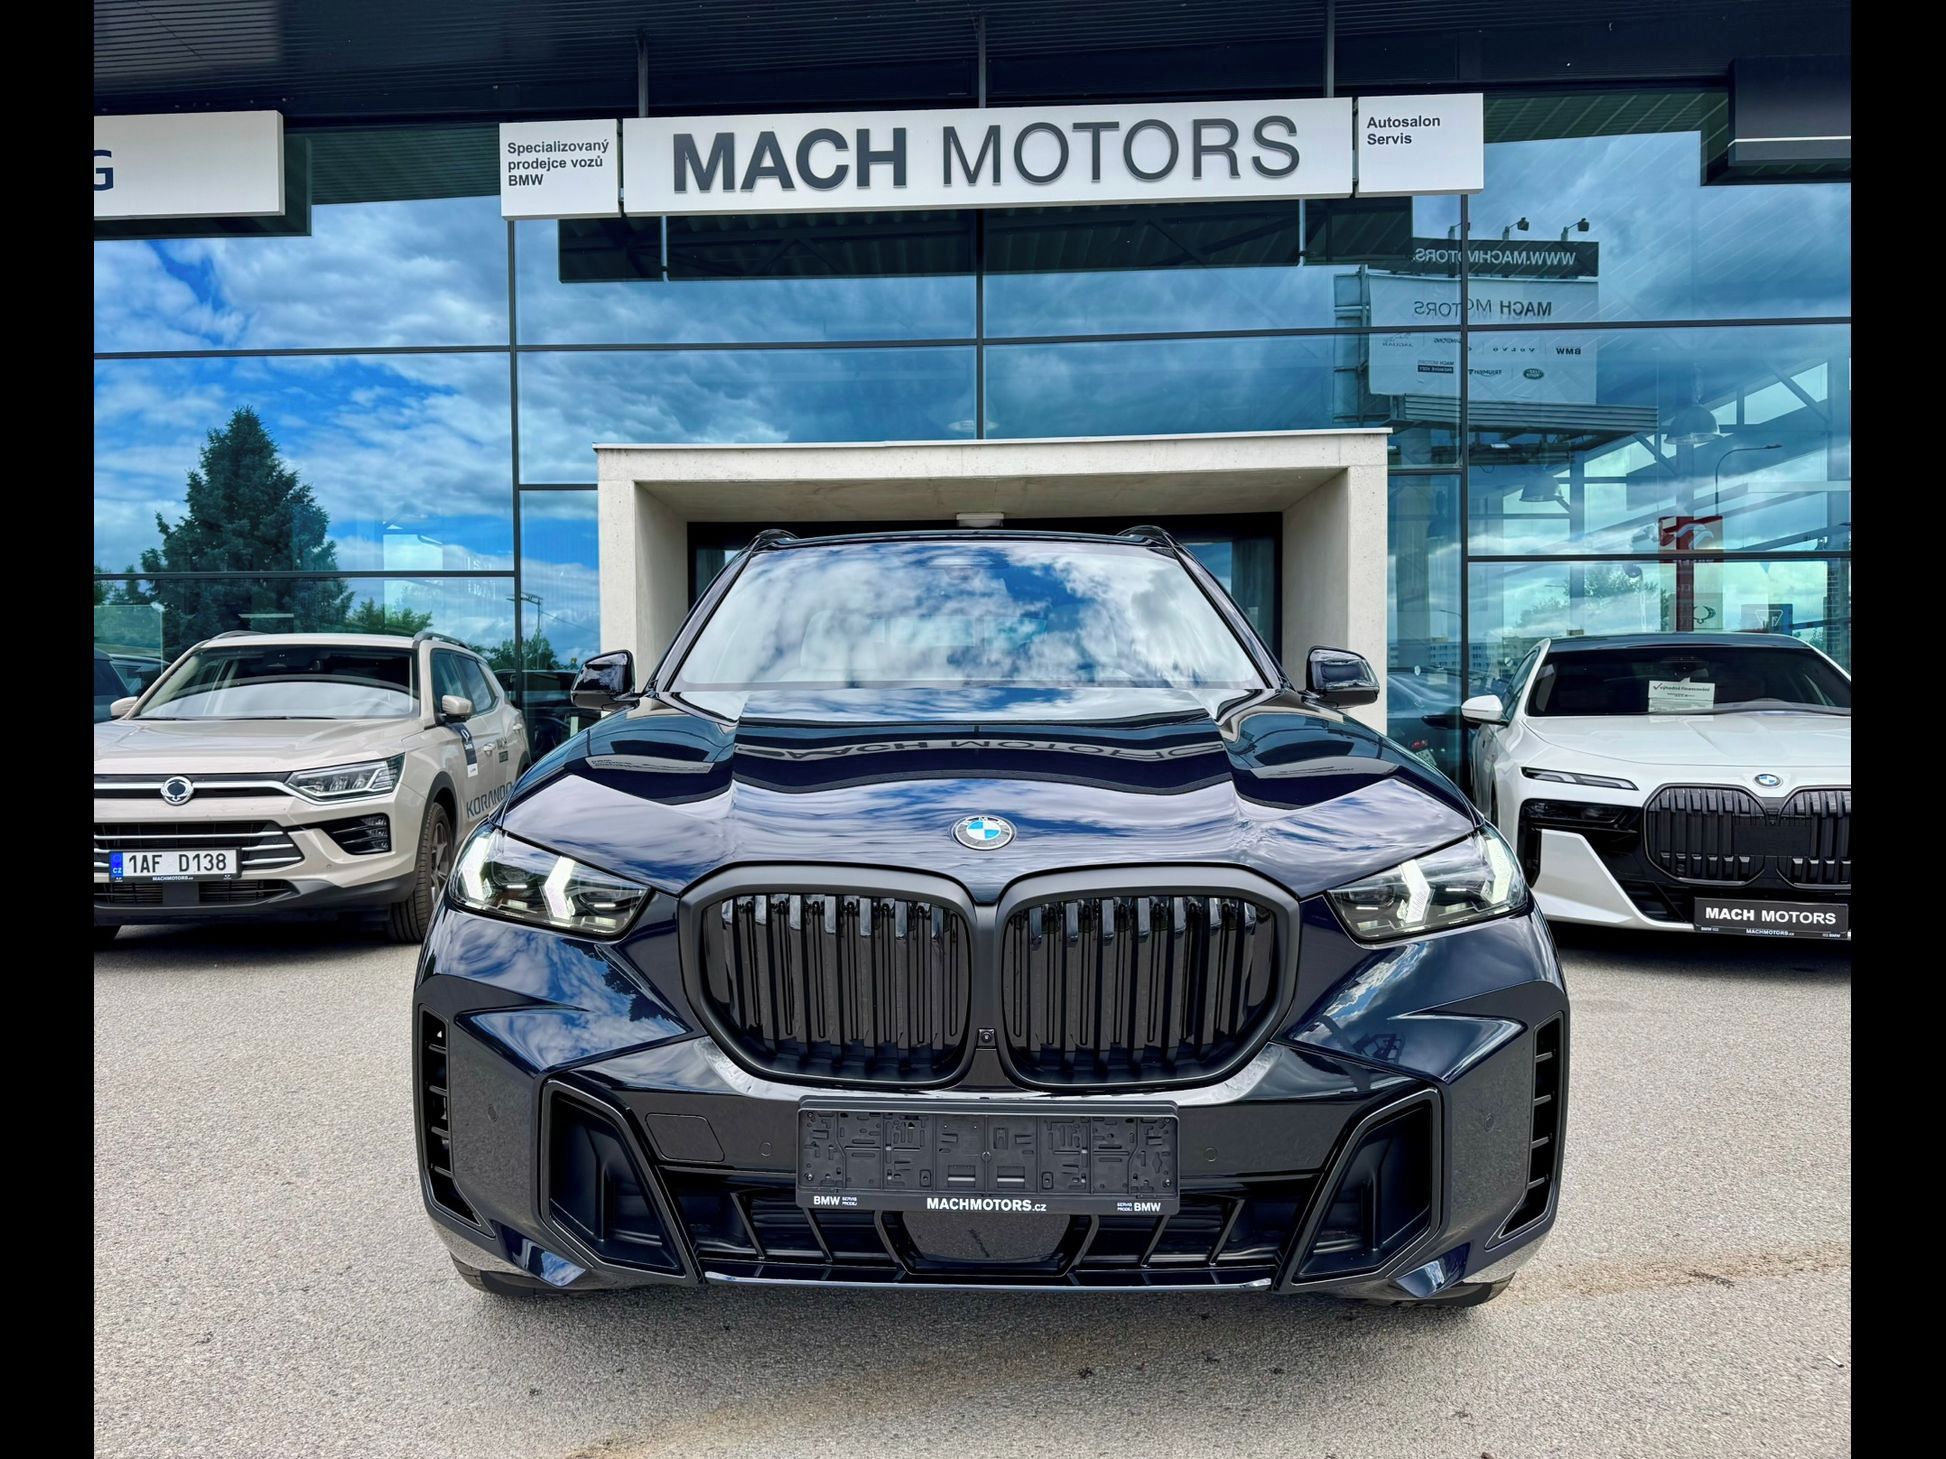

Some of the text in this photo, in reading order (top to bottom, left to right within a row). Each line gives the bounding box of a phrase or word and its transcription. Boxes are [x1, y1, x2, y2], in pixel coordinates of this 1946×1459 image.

[1366, 115, 1441, 129] Autosalon
[1366, 132, 1412, 145] Servis
[507, 139, 609, 156] Specializovaný
[673, 116, 1300, 193] MACH MOTORS
[508, 155, 603, 173] prodejce vozů
[508, 173, 544, 187] BMW
[129, 853, 226, 873] 1AF D138
[1705, 907, 1836, 925] MACH MOTORS
[813, 1195, 840, 1205] BMW
[926, 1197, 1047, 1212] MACHMOTORS.cz
[1133, 1202, 1161, 1212] BMW
